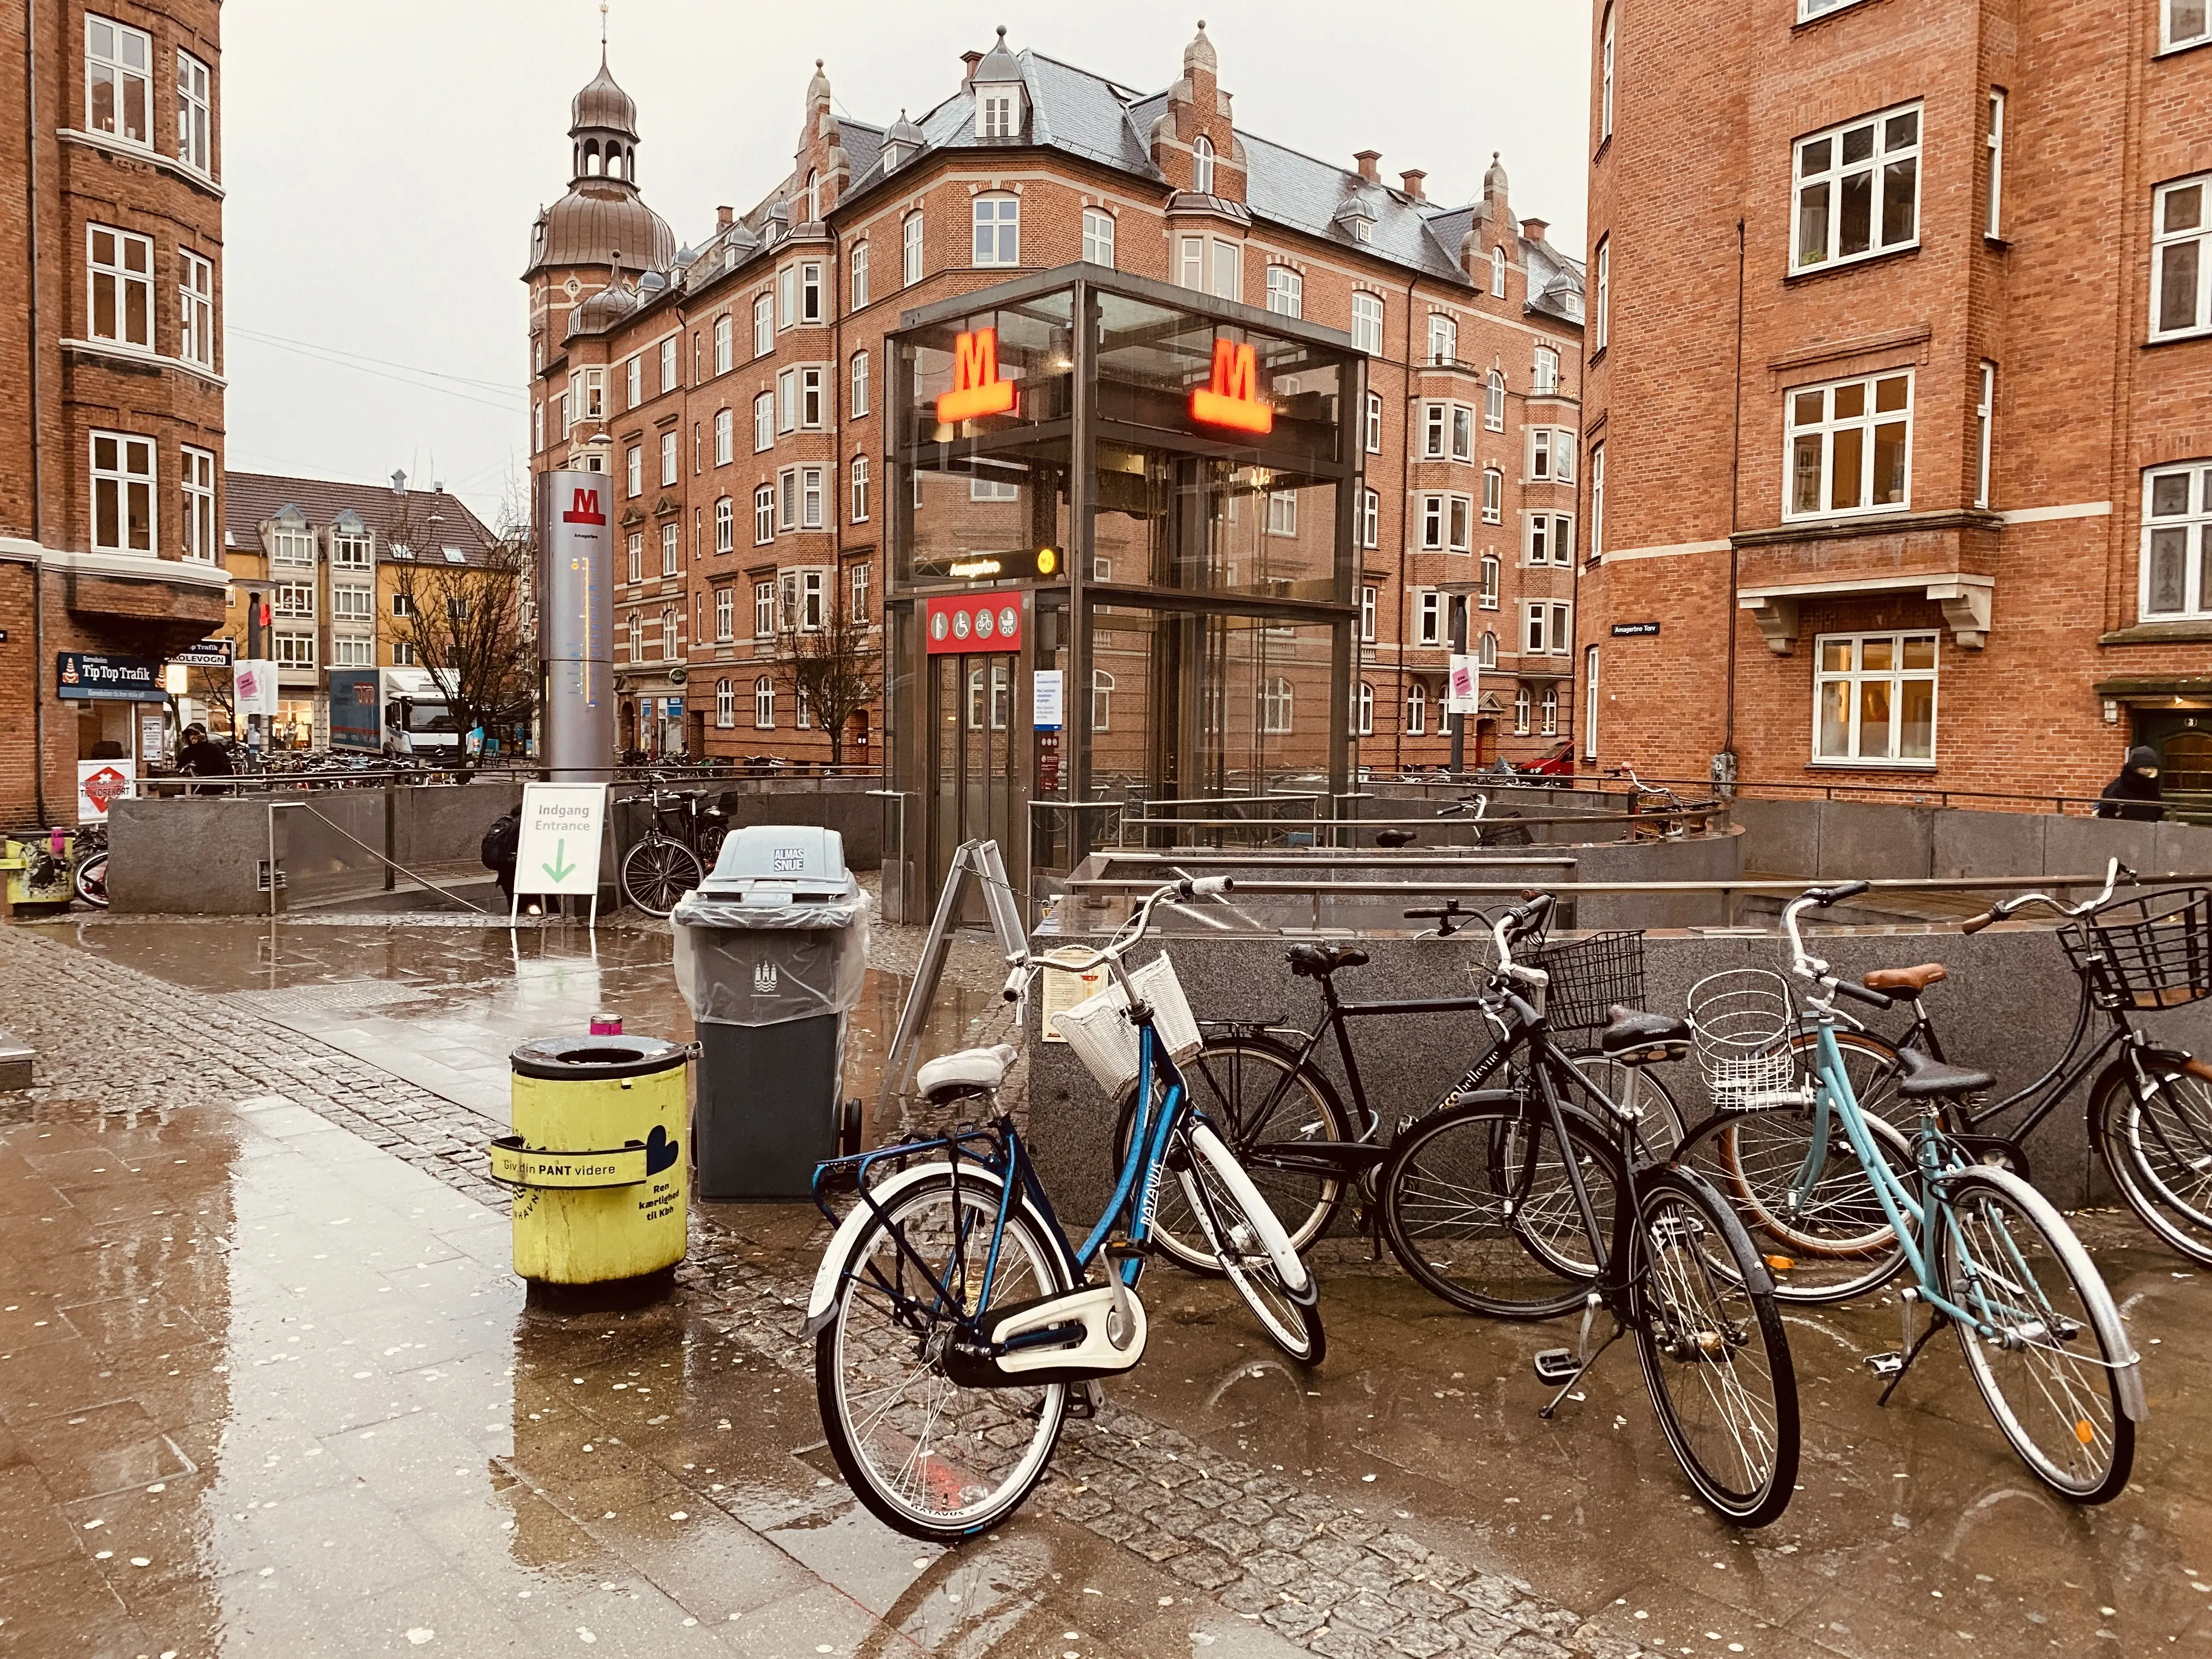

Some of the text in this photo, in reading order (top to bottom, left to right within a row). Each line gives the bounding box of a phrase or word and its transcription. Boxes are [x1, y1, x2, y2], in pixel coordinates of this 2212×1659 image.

[950, 560, 1000, 578] Amagerbro
[82, 664, 150, 682] Tip Top Trafik
[539, 804, 589, 818] Indgang
[535, 820, 590, 831] Entrance
[775, 849, 803, 860] ALMAS
[774, 859, 803, 871] SNUE
[1455, 1051, 1500, 1093] bellevue
[504, 1160, 615, 1176] Giv din PANT videre
[653, 1183, 669, 1194] Ren
[1140, 1158, 1162, 1226] BATAVUS
[639, 1188, 679, 1210] kærlighed
[646, 1205, 674, 1221] til Kbh
